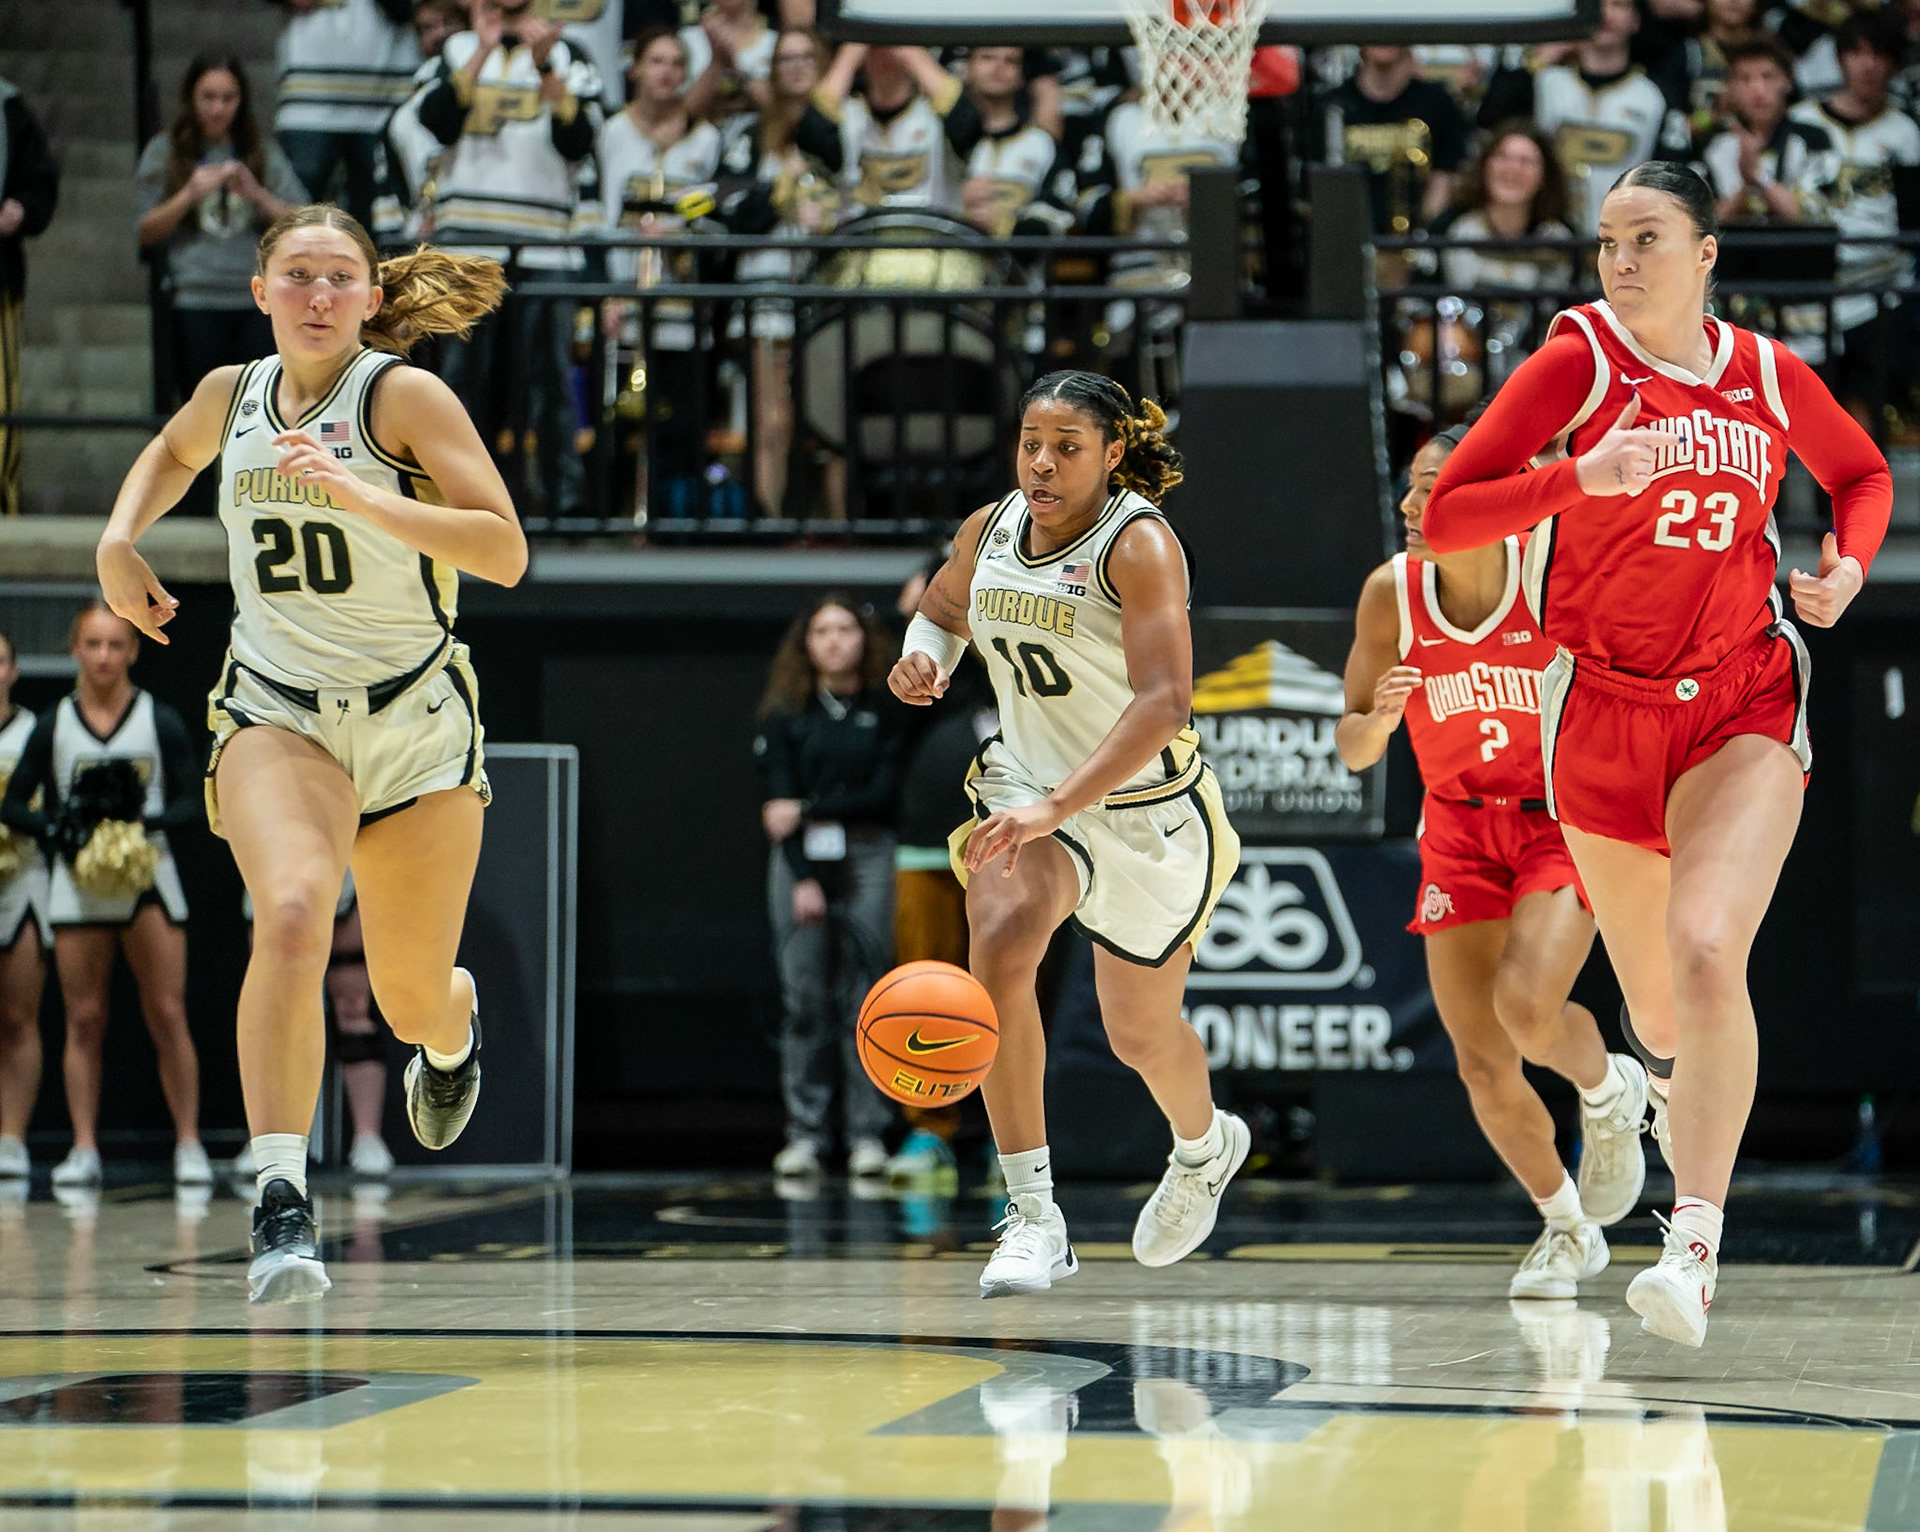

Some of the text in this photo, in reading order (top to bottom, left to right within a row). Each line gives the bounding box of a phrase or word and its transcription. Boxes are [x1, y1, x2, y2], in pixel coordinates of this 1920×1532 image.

[235, 467, 346, 510] PURDU
[1654, 490, 1740, 552] 23
[251, 518, 353, 595] 20
[976, 588, 1076, 638] PURDUE
[991, 636, 1073, 698] 10
[1194, 715, 1336, 756] URDU
[1479, 718, 1510, 763] 2
[1182, 1004, 1394, 1070] ONEER
[891, 1069, 971, 1098] ELITE
